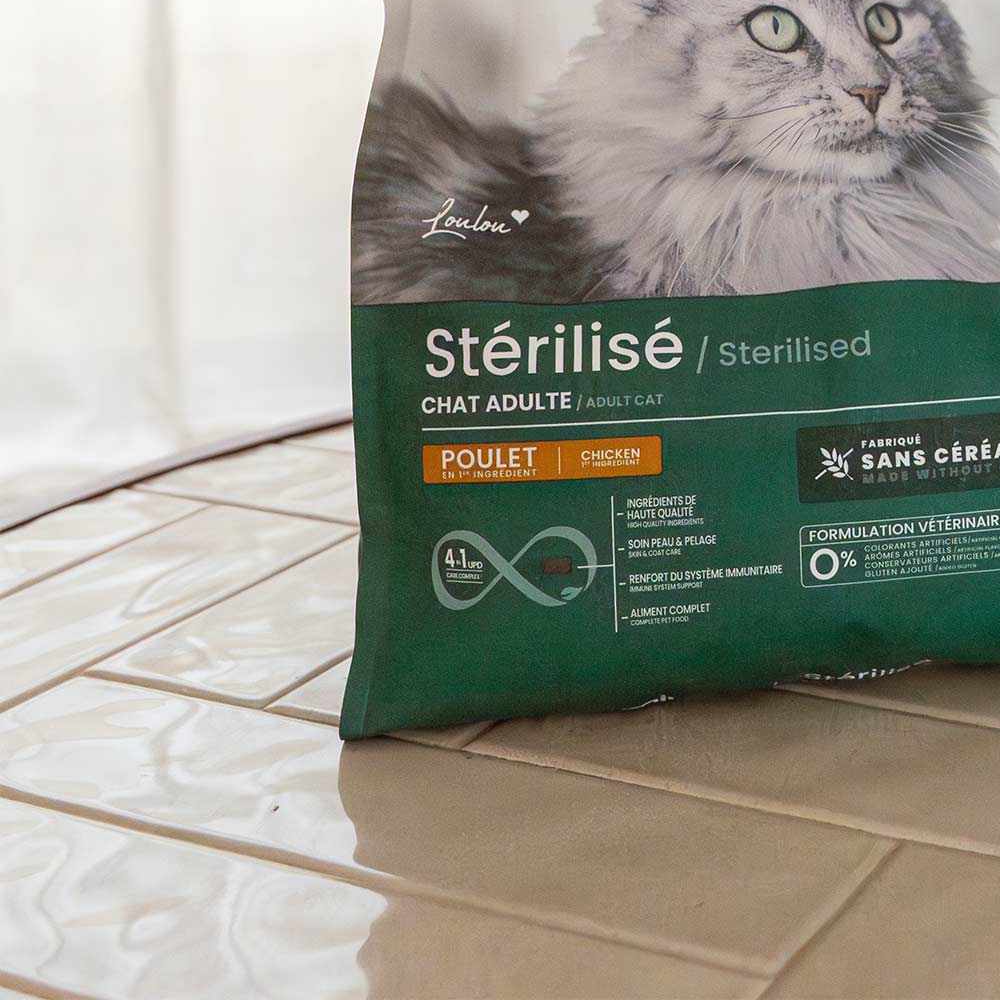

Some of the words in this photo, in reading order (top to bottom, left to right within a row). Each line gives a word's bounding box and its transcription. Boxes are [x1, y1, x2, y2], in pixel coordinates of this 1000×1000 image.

[421, 197, 512, 240] Loulou
[425, 316, 683, 378] Stérilisé
[719, 330, 872, 366] Sterilised
[422, 396, 480, 414] CHAT
[485, 392, 572, 413] ADULTE
[586, 394, 632, 409] ADULT
[637, 393, 664, 406] CAT
[861, 433, 921, 449] FABRIQUÉ
[441, 447, 538, 469] POULET
[581, 448, 641, 461] CHICKEN
[862, 450, 926, 470] SANS
[442, 471, 455, 479] EN
[917, 463, 993, 480] WITHOUT
[627, 495, 684, 508] INGRÉDIENTS
[685, 495, 697, 505] DE
[627, 508, 656, 520] HAUTE
[658, 506, 694, 518] QUALITÉ
[809, 522, 915, 541] FORMULATION
[628, 538, 650, 549] SOIN
[651, 537, 673, 548] PEAU
[675, 536, 683, 546] &
[684, 534, 717, 546] PELAGE
[864, 541, 917, 552] COLORANTS
[903, 547, 952, 557] ARTIFICIELS
[864, 556, 938, 569] CONSERVATEURS
[941, 552, 988, 562] ARTIFICIELS
[629, 572, 668, 584] RENFORT
[670, 571, 683, 581] DU
[684, 567, 724, 580] SYSTÈME
[725, 564, 784, 577] IMMUNITAIRE
[864, 568, 898, 578] GLUTEN
[900, 564, 933, 574] AJOUTÉ
[630, 606, 667, 618] ALIMENT
[669, 603, 711, 615] COMPLET
